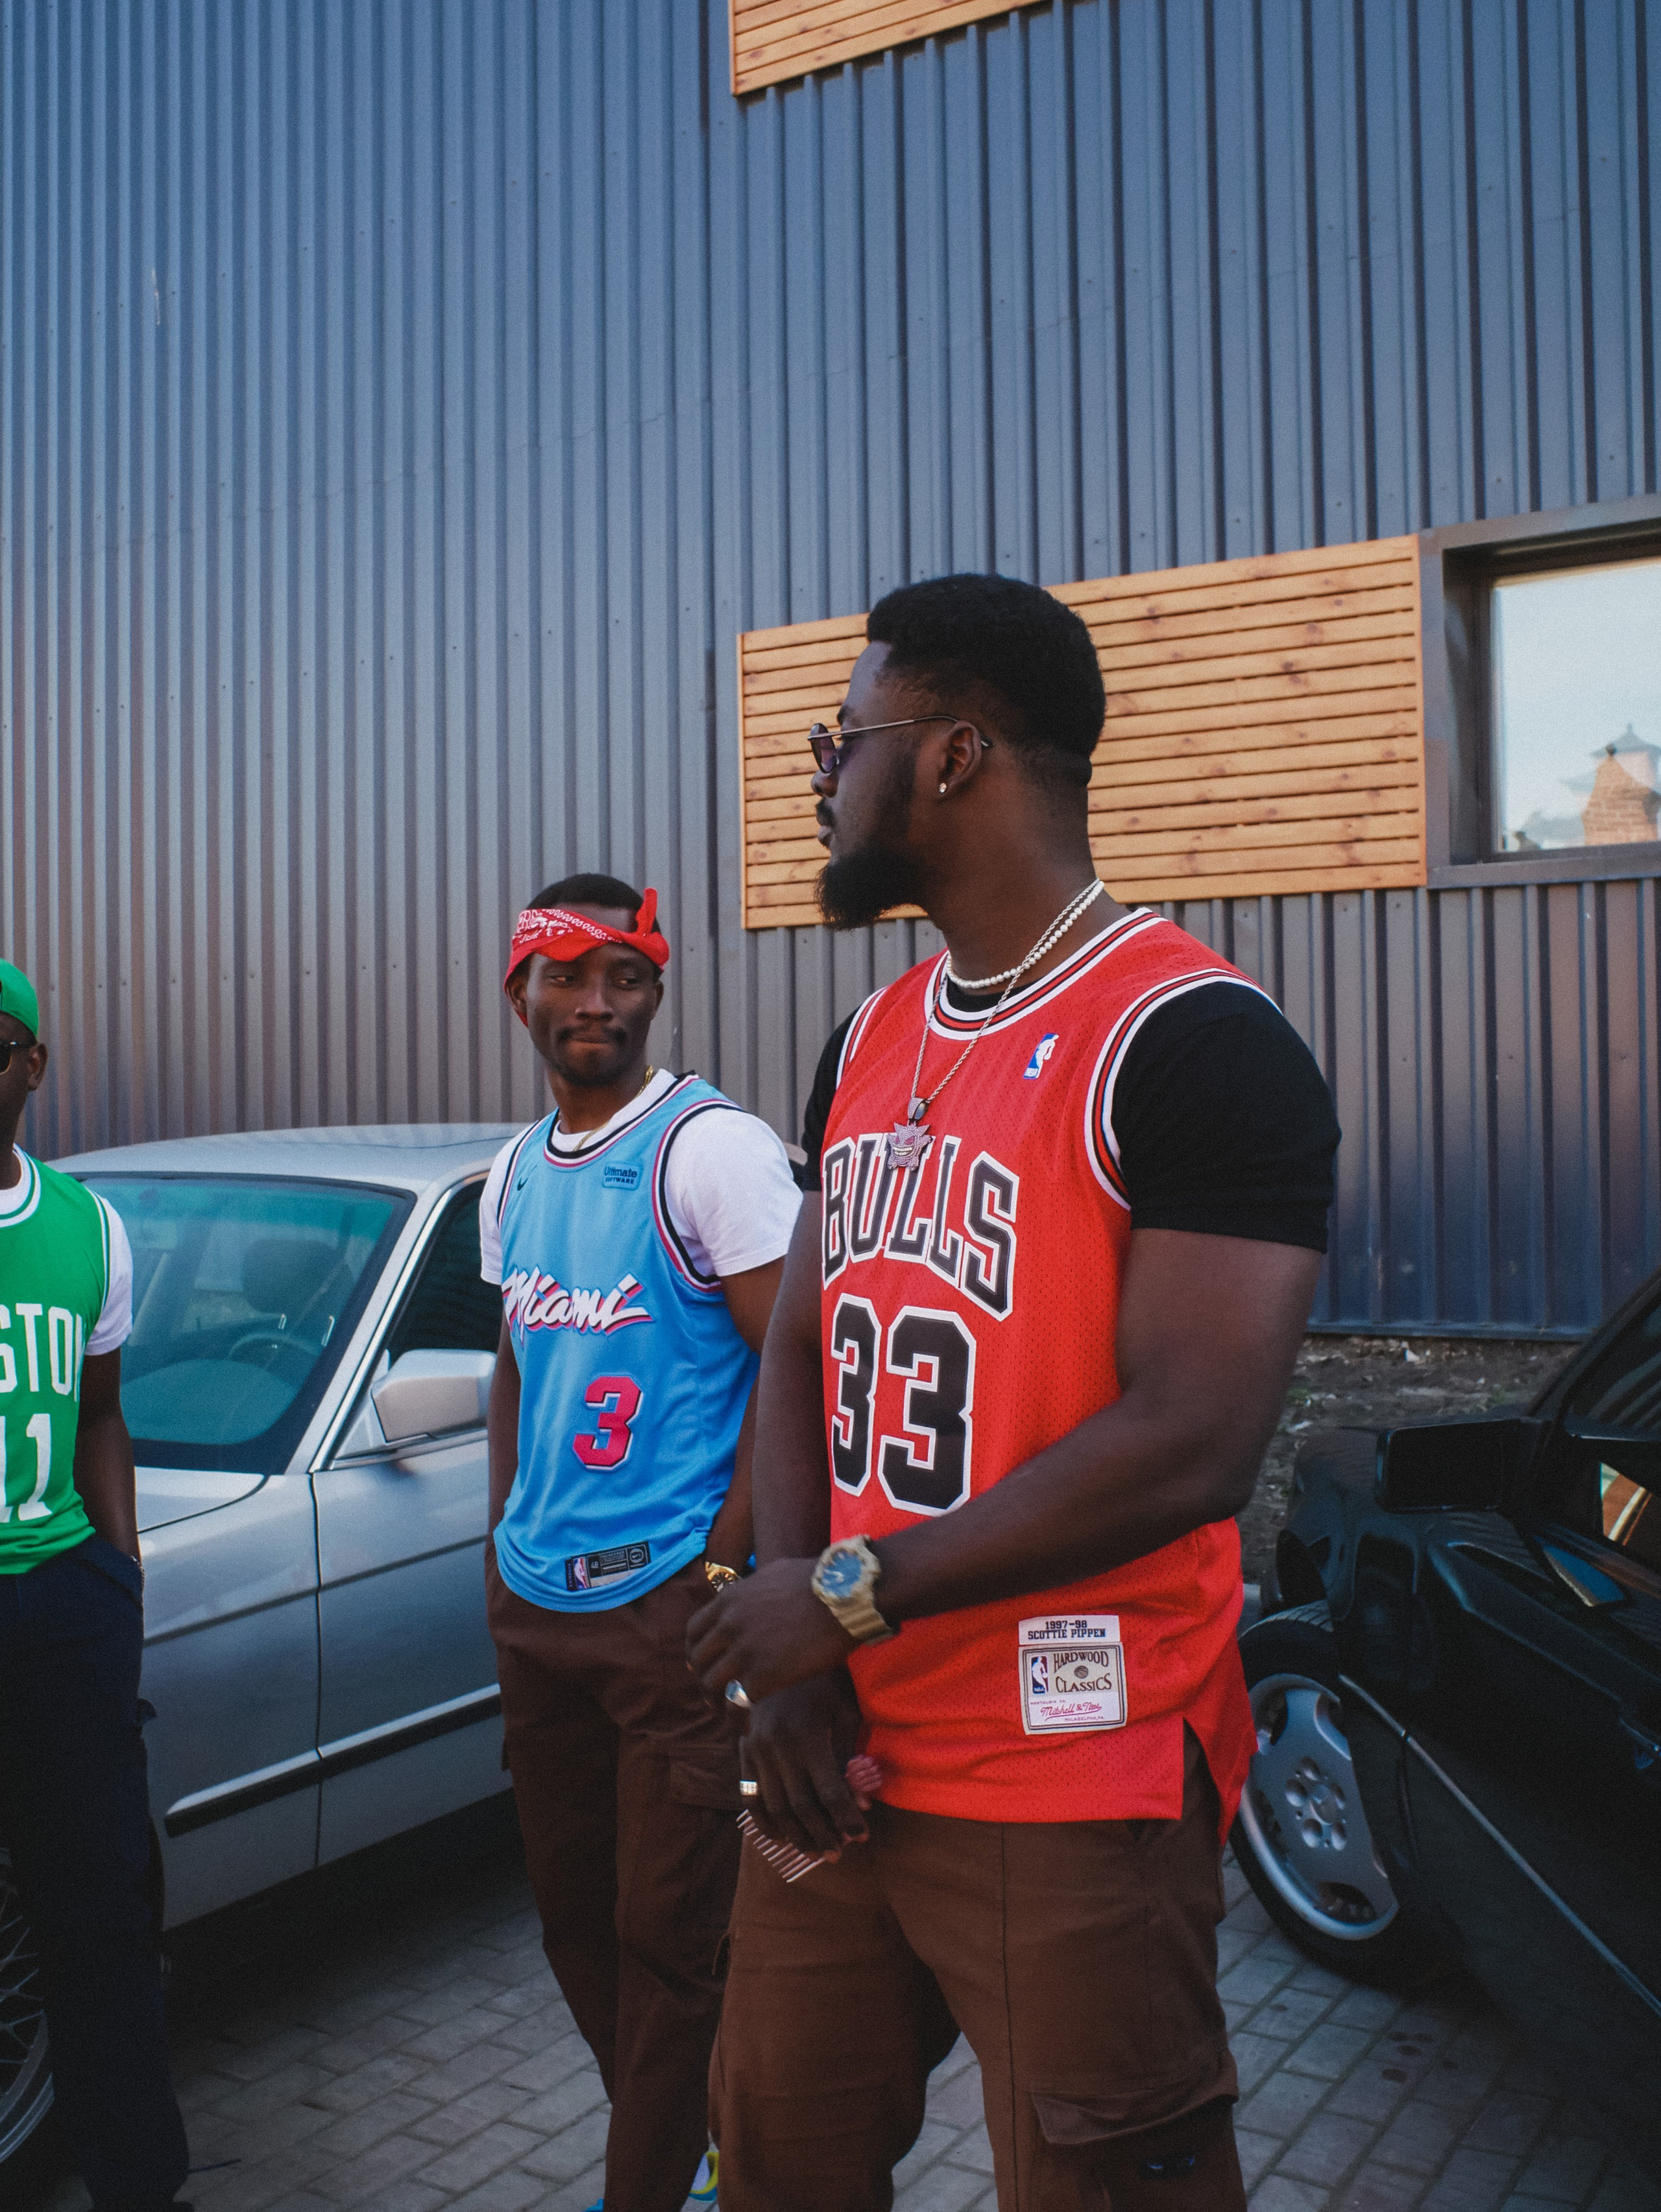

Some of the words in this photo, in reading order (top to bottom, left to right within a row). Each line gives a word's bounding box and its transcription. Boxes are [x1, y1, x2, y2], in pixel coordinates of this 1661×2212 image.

[604, 1166, 638, 1178] Ultimate
[821, 1133, 1019, 1321] BULLS
[502, 1266, 653, 1348] Miami
[831, 1293, 976, 1517] 33
[572, 1375, 644, 1472] 3
[1028, 1630, 1067, 1640] SCOTTIE
[1071, 1628, 1106, 1638] PIPPEN
[1045, 1620, 1087, 1630] 1997-98
[1053, 1651, 1109, 1674] HARDWOOD
[1040, 1703, 1075, 1716] Mitchell
